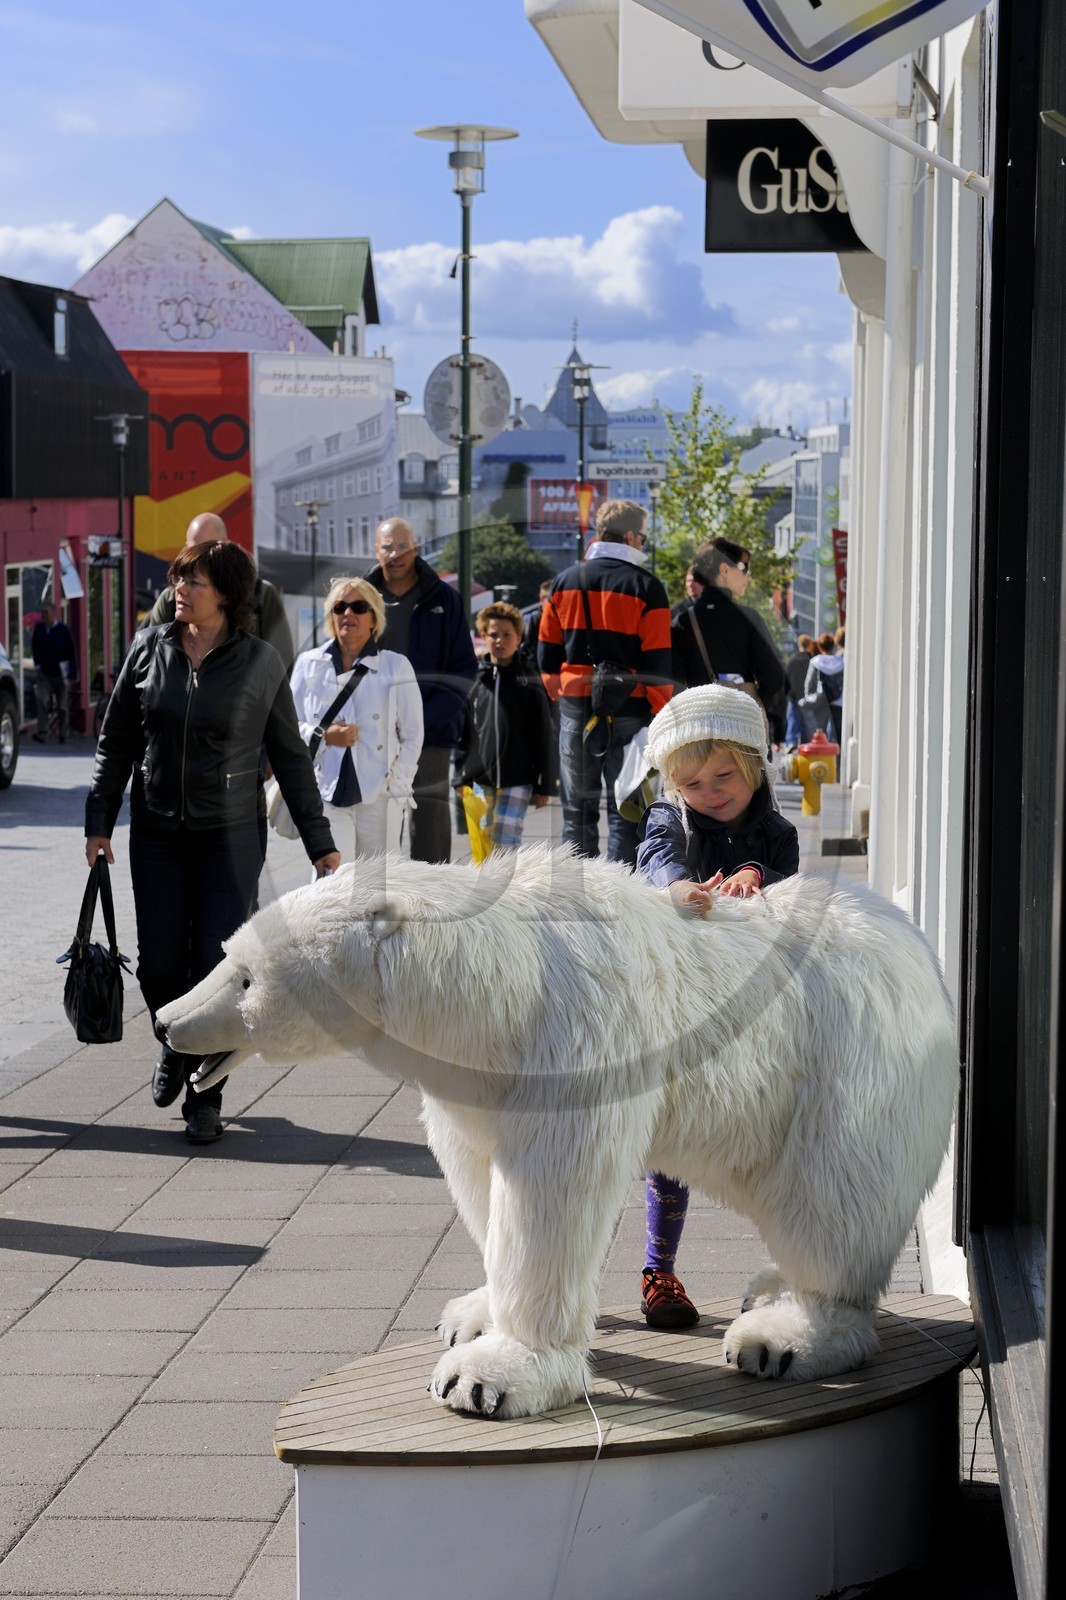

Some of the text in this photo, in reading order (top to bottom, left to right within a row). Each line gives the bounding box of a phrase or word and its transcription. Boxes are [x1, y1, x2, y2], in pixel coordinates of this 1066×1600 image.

[150, 470, 198, 480] ANT
[596, 466, 658, 477] Ingólfsstræti
[539, 485, 565, 498] 100
